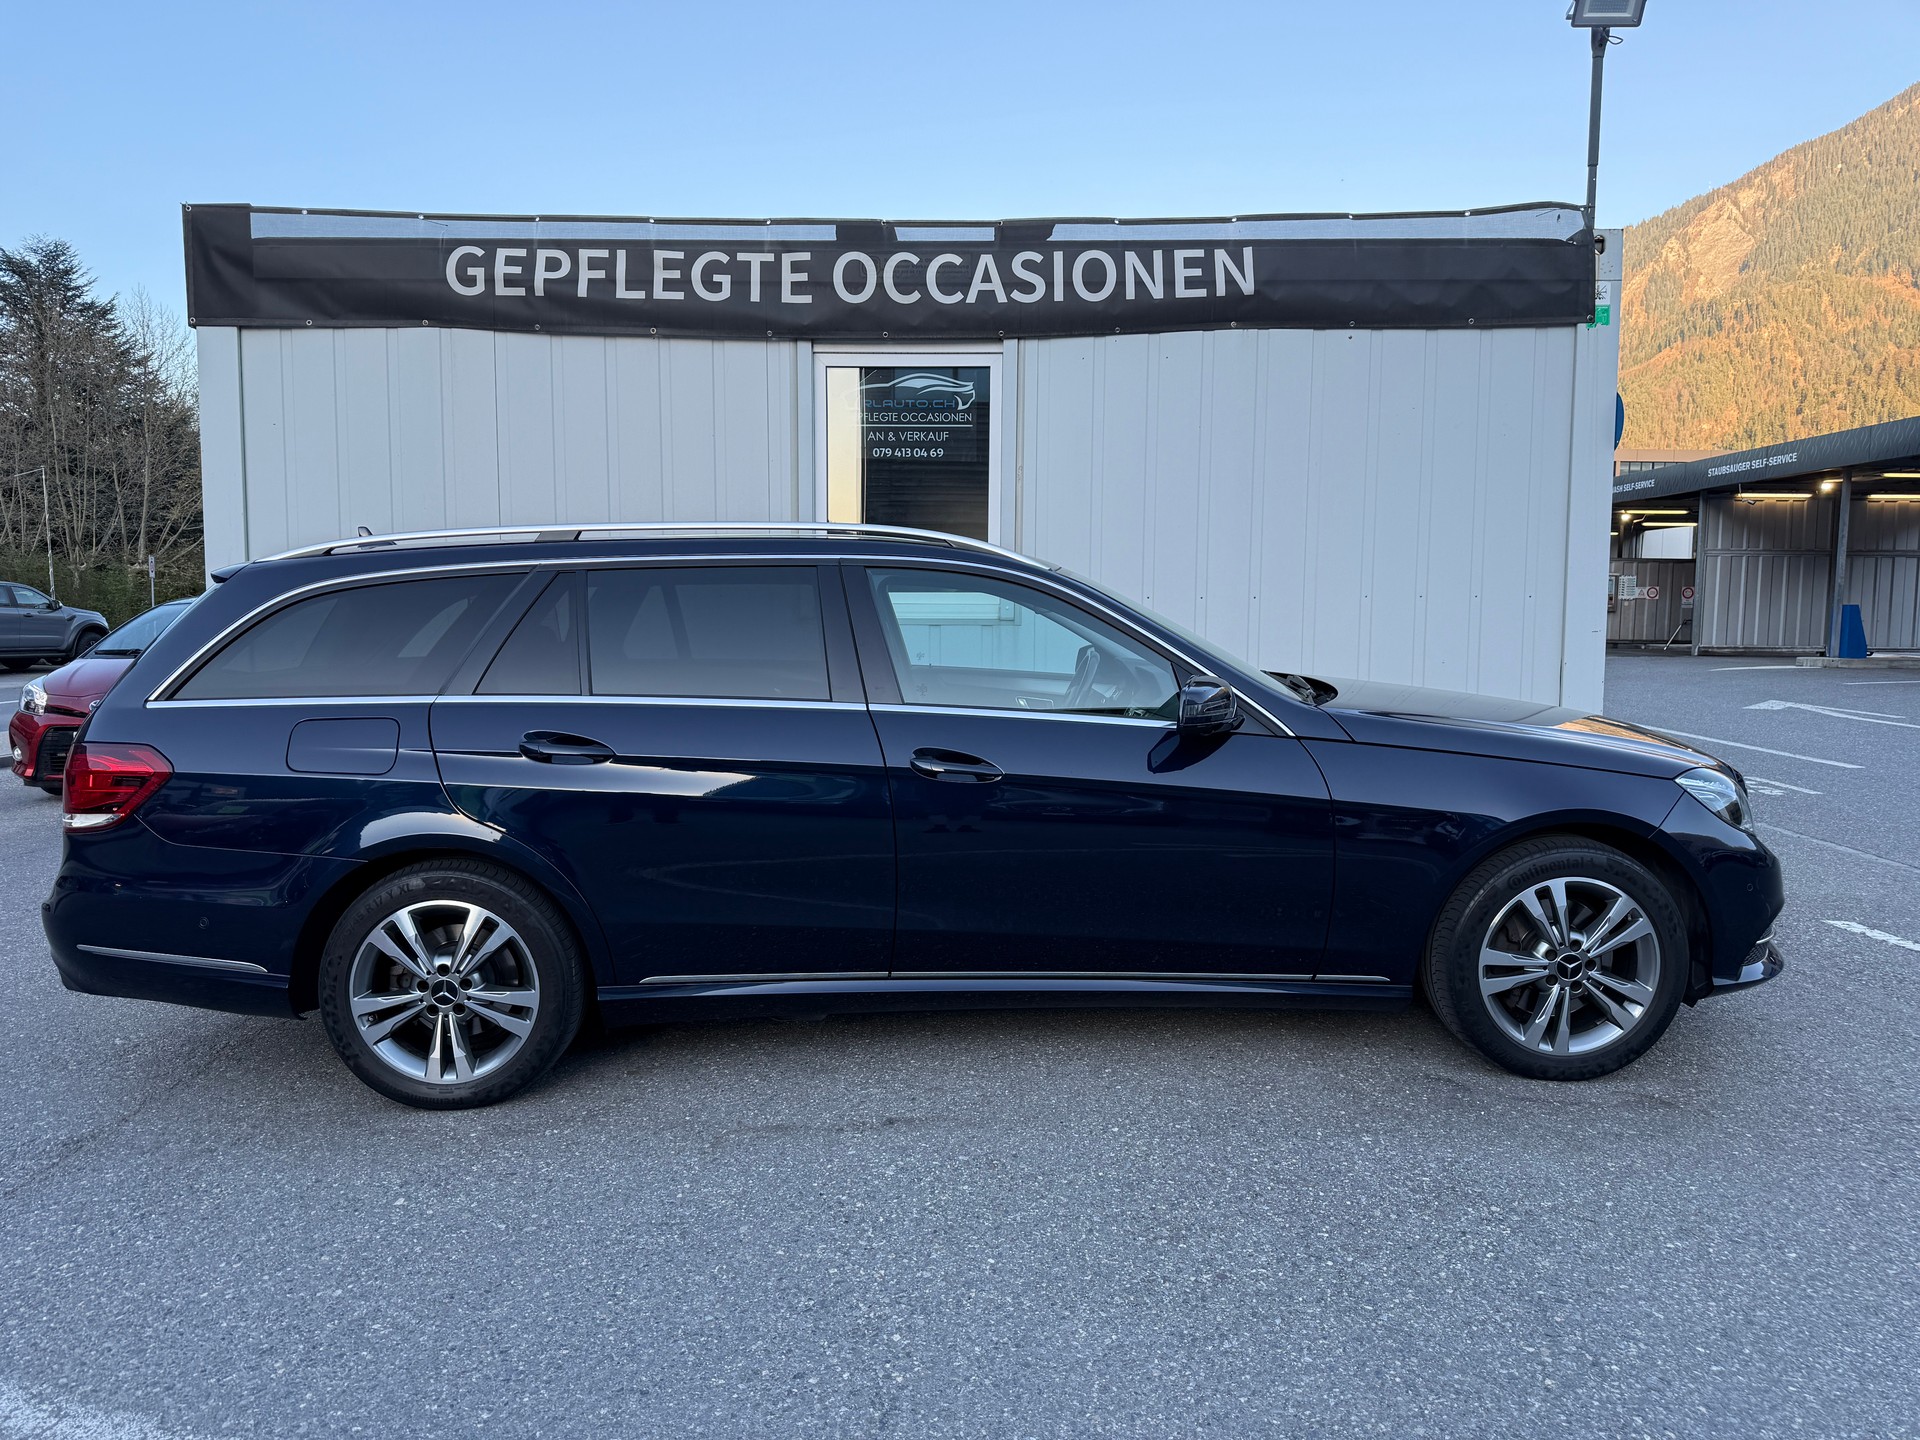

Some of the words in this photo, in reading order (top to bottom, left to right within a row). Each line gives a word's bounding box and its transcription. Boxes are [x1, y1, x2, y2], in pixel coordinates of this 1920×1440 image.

[445, 245, 813, 304] GEPFLEGTE
[832, 246, 1256, 305] OCCASIONEN
[864, 399, 956, 408] RLAUTO.CH
[859, 412, 898, 422] PFLEGTE
[900, 412, 972, 422] OCCASIONEN
[867, 431, 885, 441] AN
[887, 431, 897, 441] &
[899, 431, 949, 441] VERKAUF
[872, 448, 892, 458] 079
[894, 448, 911, 458] 413
[913, 448, 928, 458] 04
[930, 448, 944, 458] 69
[1707, 461, 1751, 477] STAUBSAUGER
[1751, 452, 1798, 469] SELF-SERVICE
[1613, 484, 1623, 493] ASH
[1623, 479, 1655, 492] SELF-SERVICE
[1507, 857, 1585, 890] Continental
